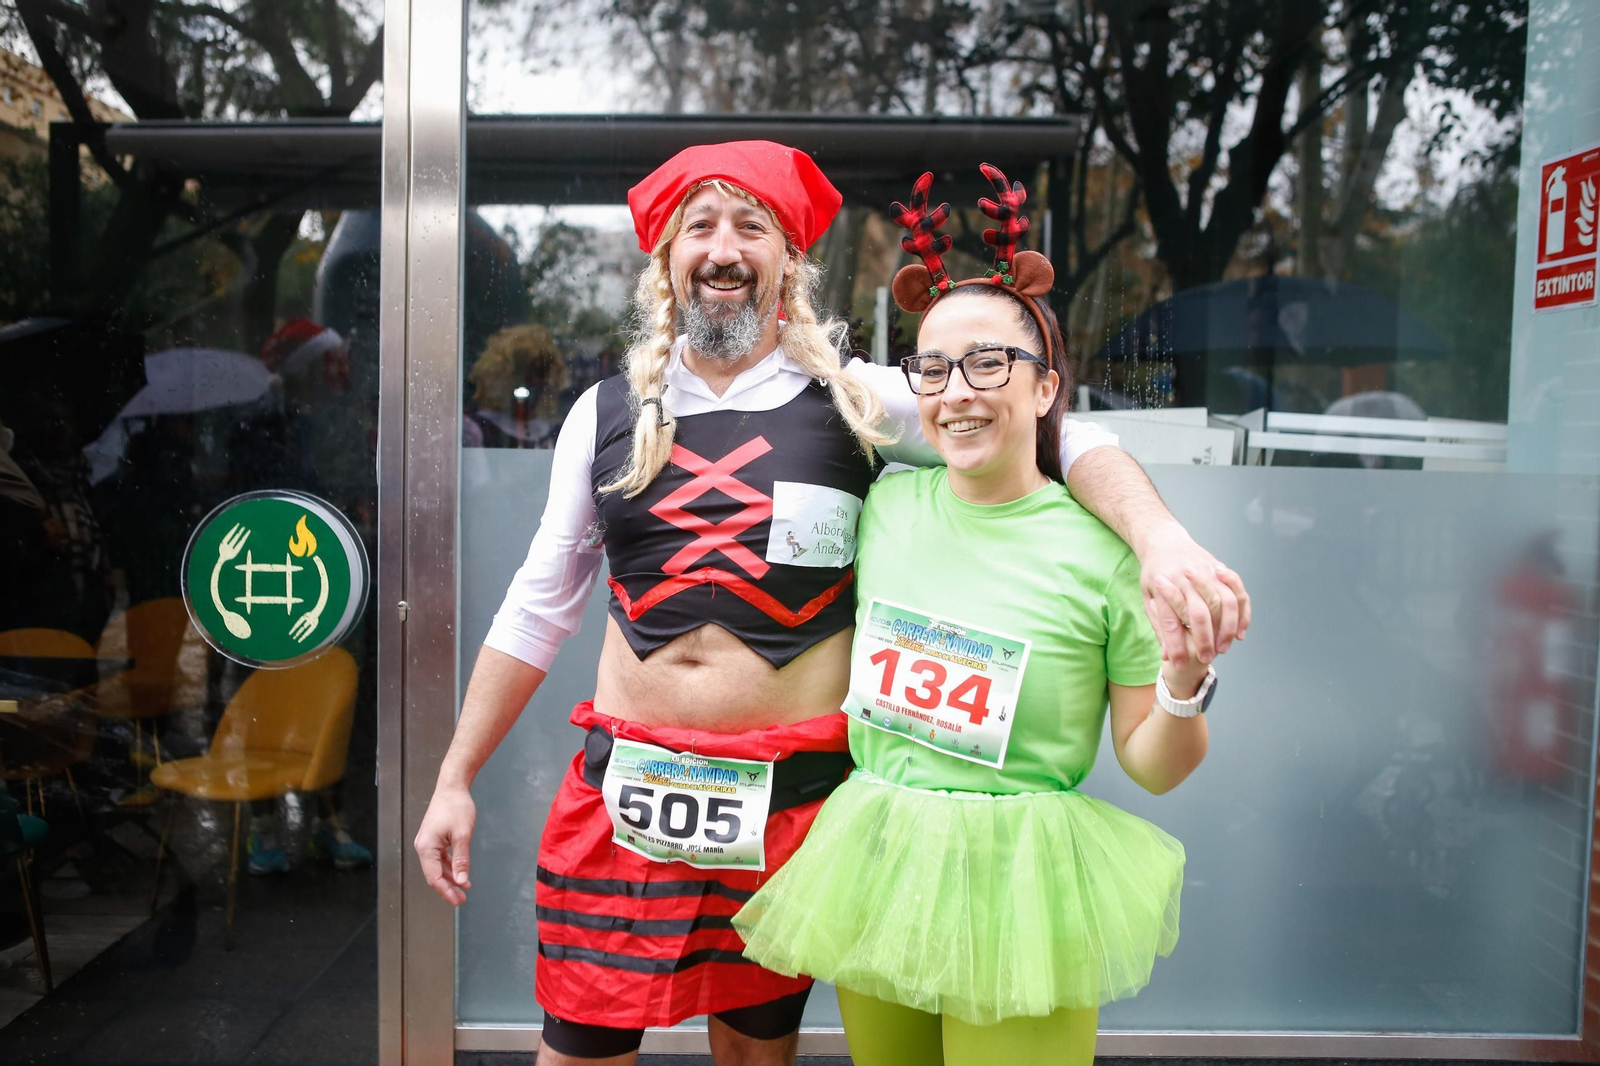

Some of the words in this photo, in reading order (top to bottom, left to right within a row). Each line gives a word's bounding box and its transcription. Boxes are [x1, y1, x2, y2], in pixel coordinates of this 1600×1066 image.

[1536, 270, 1594, 298] EXTINTOR
[837, 505, 848, 521] Las
[892, 618, 942, 649] CARRERA
[943, 633, 993, 662] NAVIDAD
[950, 655, 988, 671] ALGECIRAS
[870, 648, 992, 725] 134
[875, 698, 901, 713] CASTILLO
[901, 707, 935, 726] FERNÁNDEZ,
[936, 718, 962, 734] ROSALÍA
[637, 758, 686, 780] CARRERA
[689, 765, 739, 786] NAVIDAD
[671, 781, 690, 789] CIUDAD
[698, 784, 736, 794] ALGECIRAS
[619, 784, 743, 844] 505
[656, 838, 685, 852] PIZZARRO,
[703, 845, 724, 854] MARÍA
